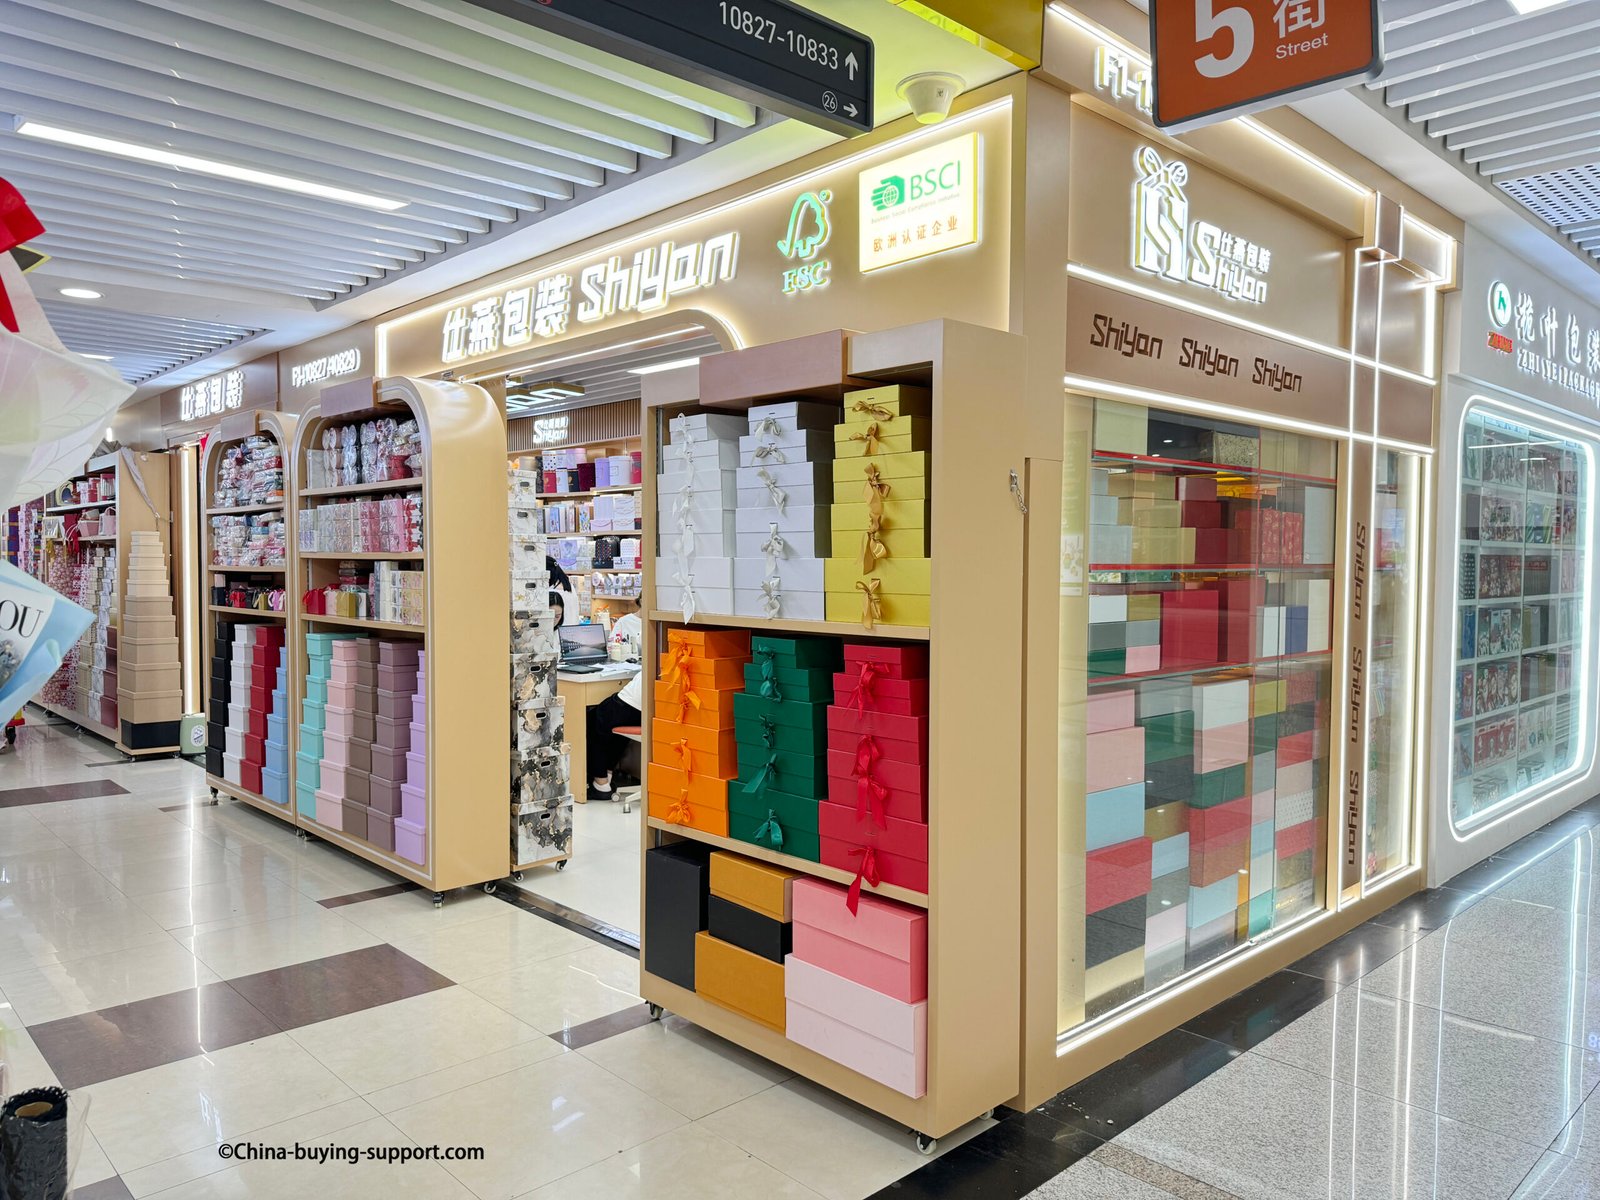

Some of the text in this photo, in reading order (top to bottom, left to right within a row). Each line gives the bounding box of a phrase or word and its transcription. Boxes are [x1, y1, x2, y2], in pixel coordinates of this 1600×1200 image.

[719, 1, 838, 70] 10827-10833
[1194, 0, 1326, 78] 5 街
[1275, 32, 1329, 60] Street
[823, 93, 836, 111] 26
[909, 160, 962, 201] BSCI
[872, 214, 959, 253] 欧洲认证企业
[782, 260, 829, 293] FSC
